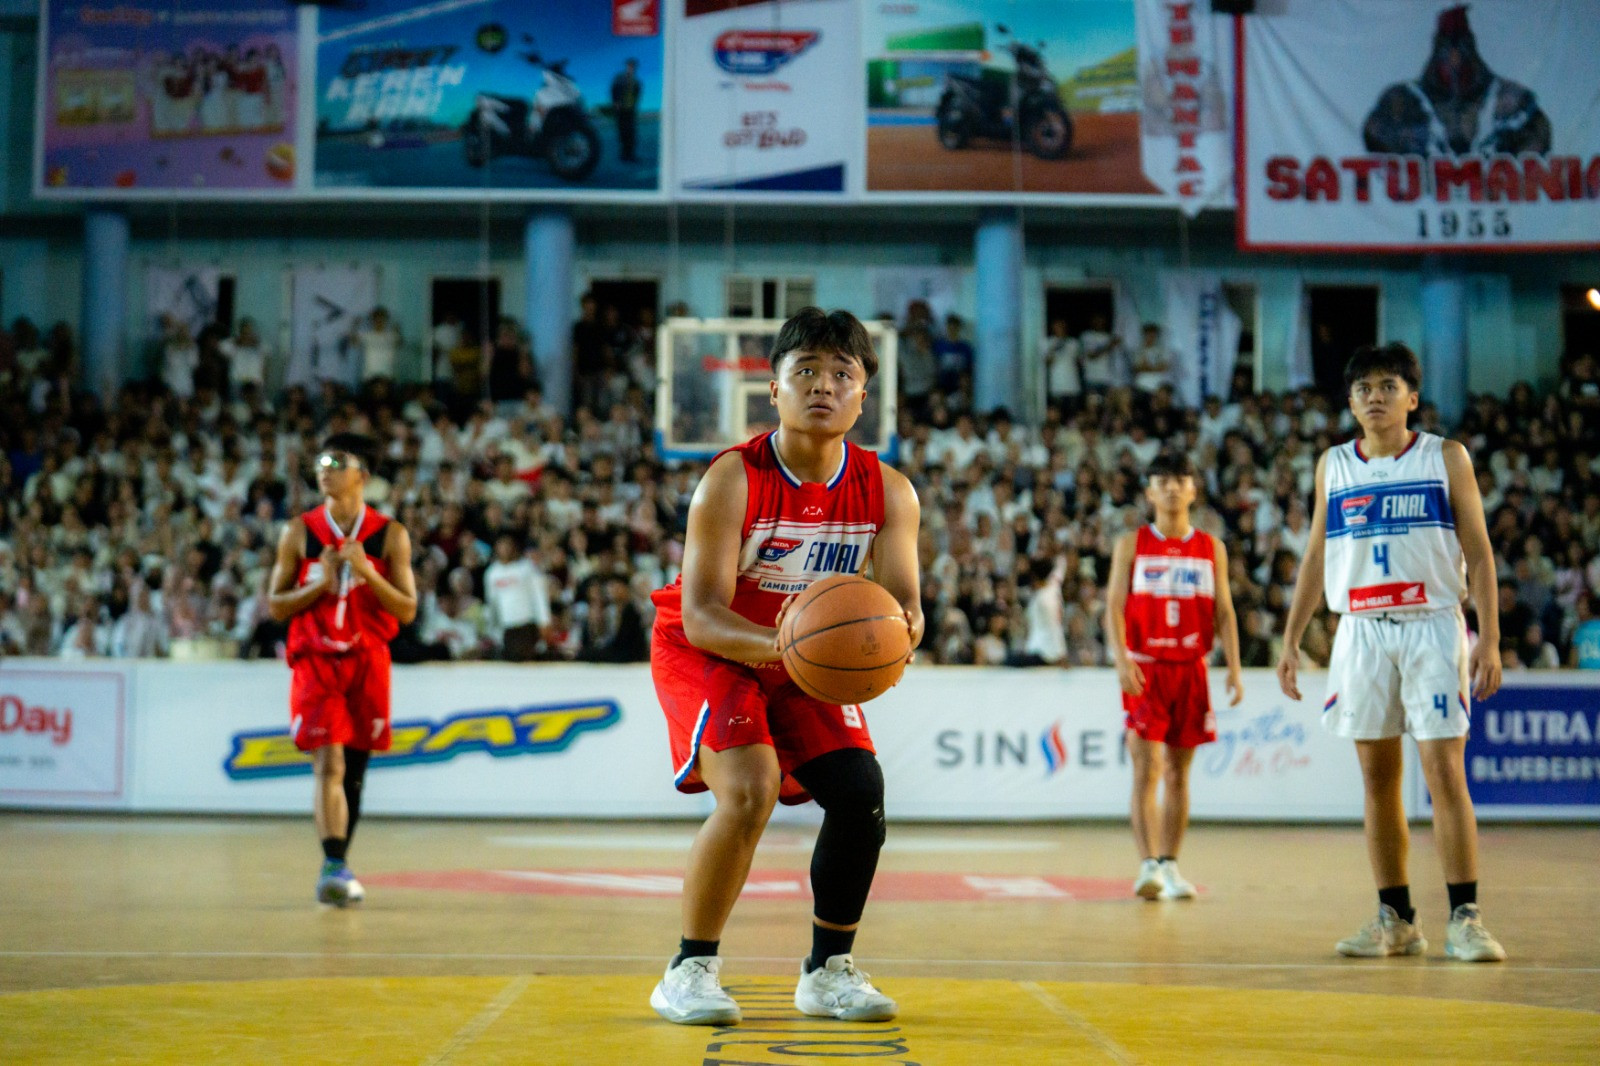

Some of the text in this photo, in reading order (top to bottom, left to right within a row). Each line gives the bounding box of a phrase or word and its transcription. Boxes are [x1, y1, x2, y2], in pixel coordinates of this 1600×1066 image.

[1265, 156, 1421, 204] SATU
[1416, 208, 1512, 238] 1955
[1381, 494, 1428, 519] FINAL
[803, 541, 860, 574] FINAL
[1373, 542, 1391, 576] 4
[761, 581, 789, 591] JAMBI
[1433, 693, 1449, 719] 4
[1485, 710, 1593, 744] ULTRA
[936, 719, 1126, 776] SINSE
